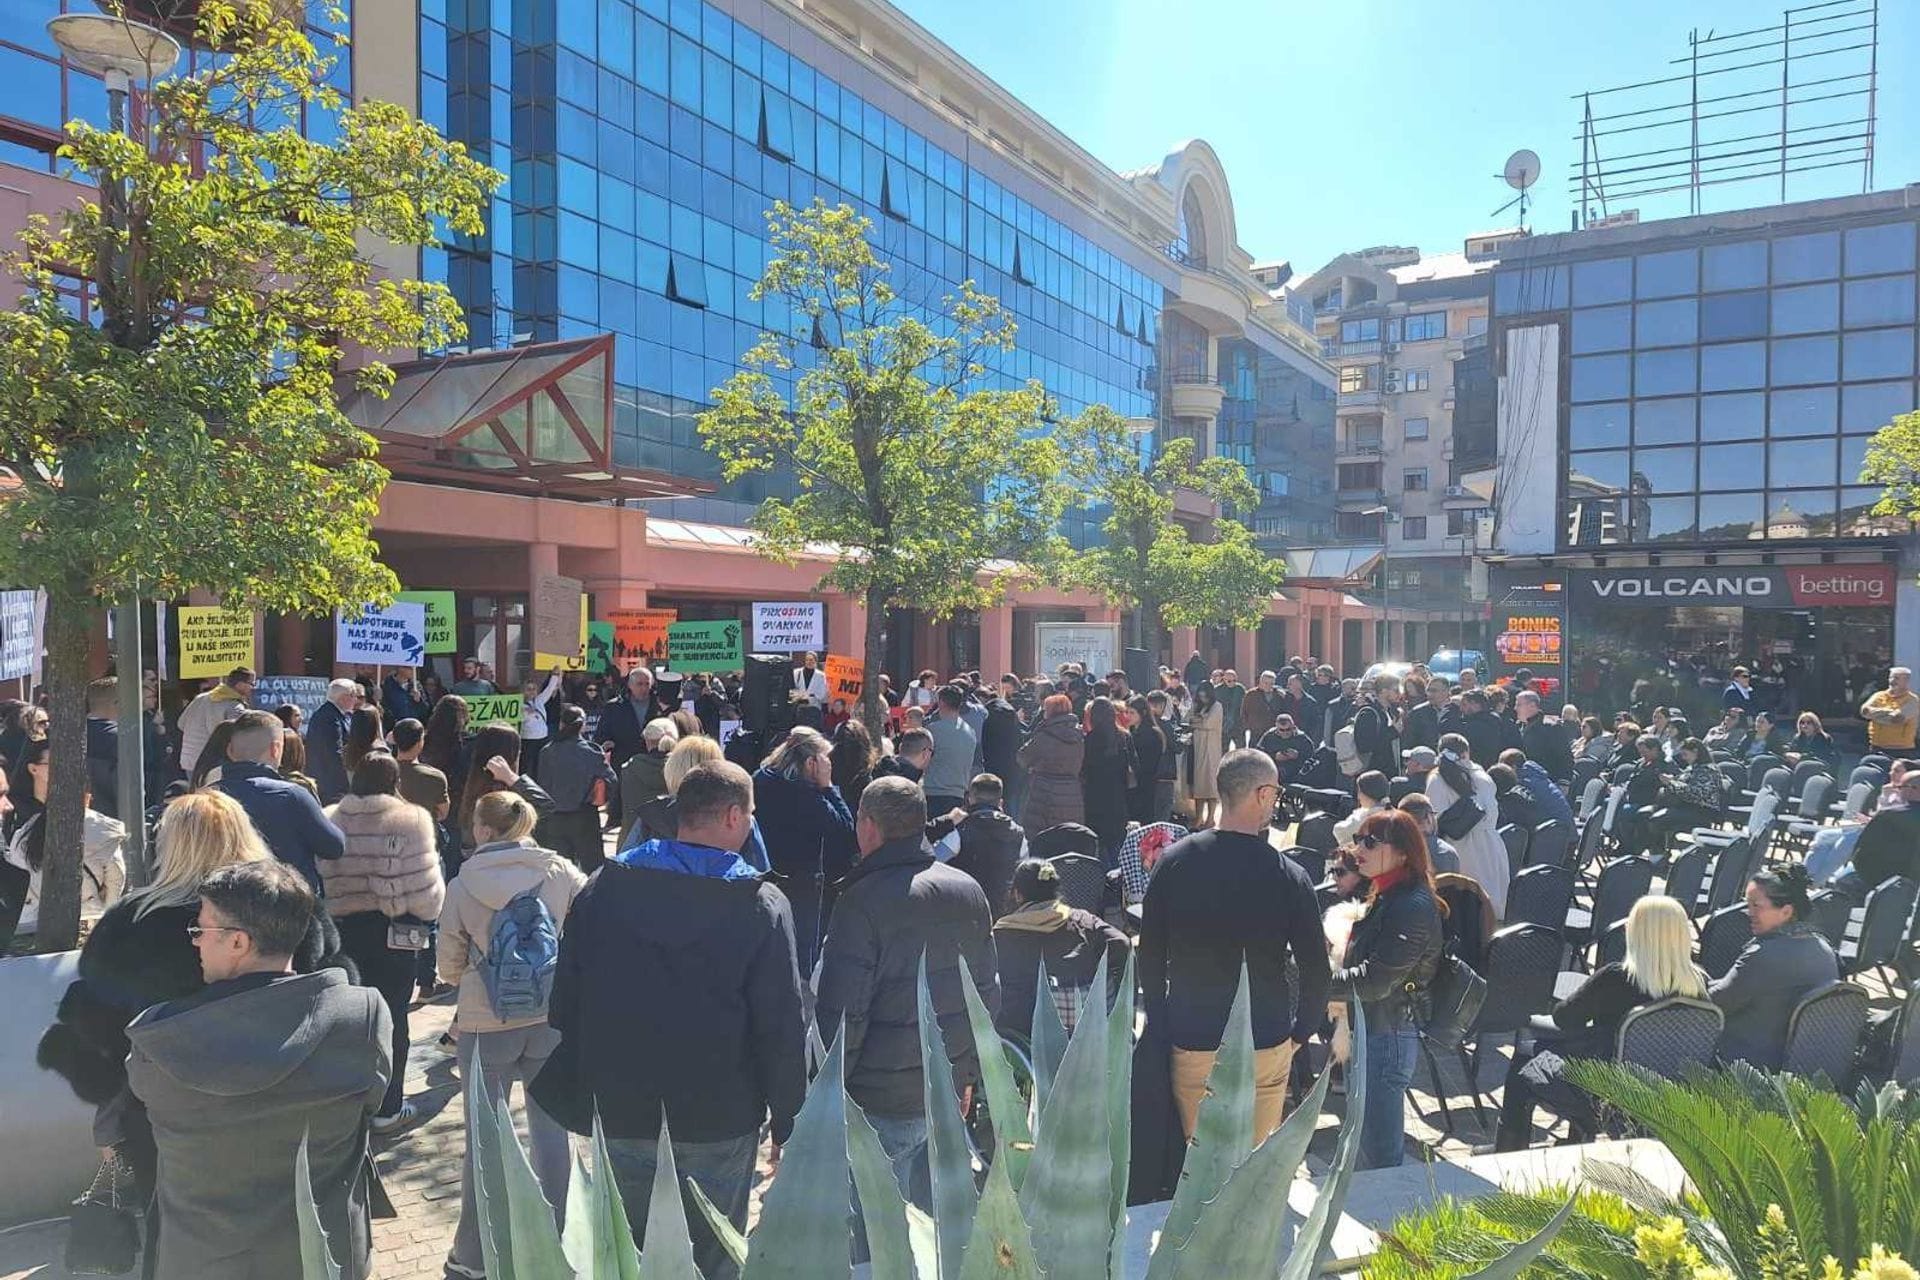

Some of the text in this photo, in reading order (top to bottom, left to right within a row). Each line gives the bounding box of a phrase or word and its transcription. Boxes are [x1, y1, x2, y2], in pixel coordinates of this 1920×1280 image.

[1592, 574, 1883, 598] VOLCANO betting
[760, 607, 815, 617] PRKOSIMO
[187, 615, 204, 626] AKO
[762, 620, 814, 631] OVAKVOM
[1508, 617, 1560, 632] BONUS
[370, 630, 399, 641] SKUPO
[196, 639, 217, 651] NAŠE
[467, 697, 519, 721] RŽAVO
